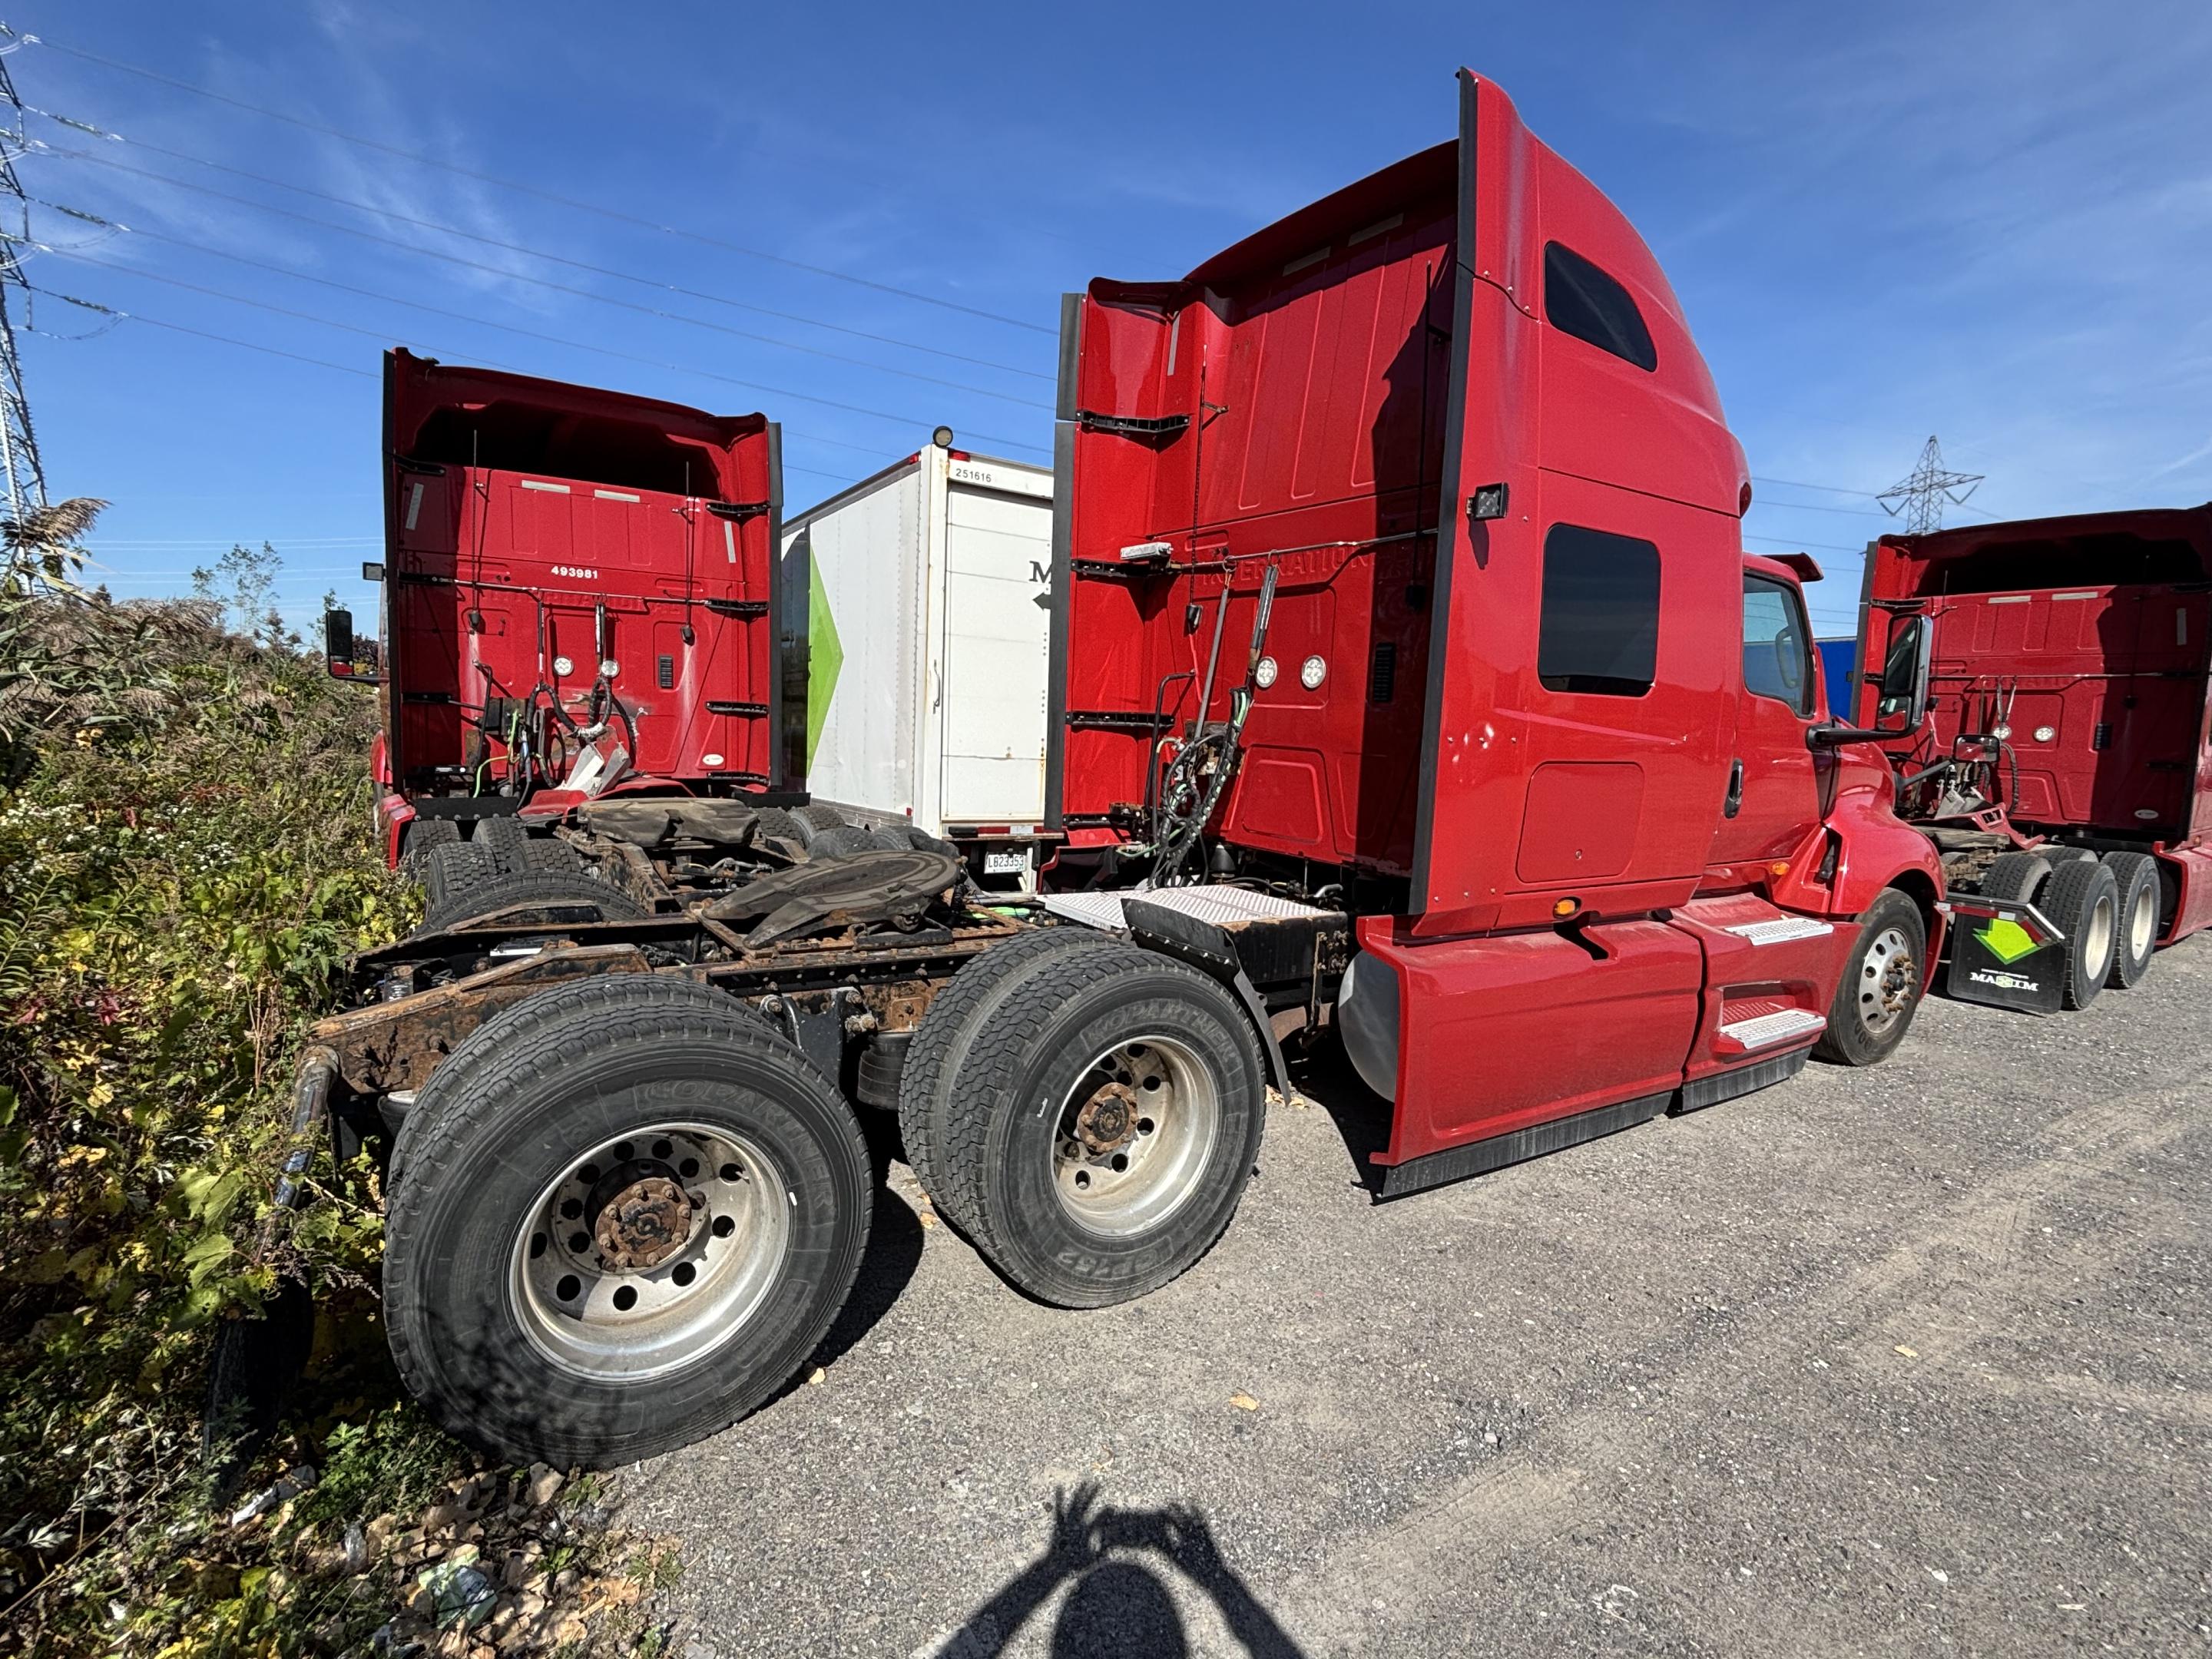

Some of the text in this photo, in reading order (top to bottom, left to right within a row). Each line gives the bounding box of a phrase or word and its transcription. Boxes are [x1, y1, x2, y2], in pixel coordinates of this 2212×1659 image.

[955, 468, 992, 482] 251616
[551, 565, 598, 579] 493981
[645, 1079, 834, 1211] COPARTNER
